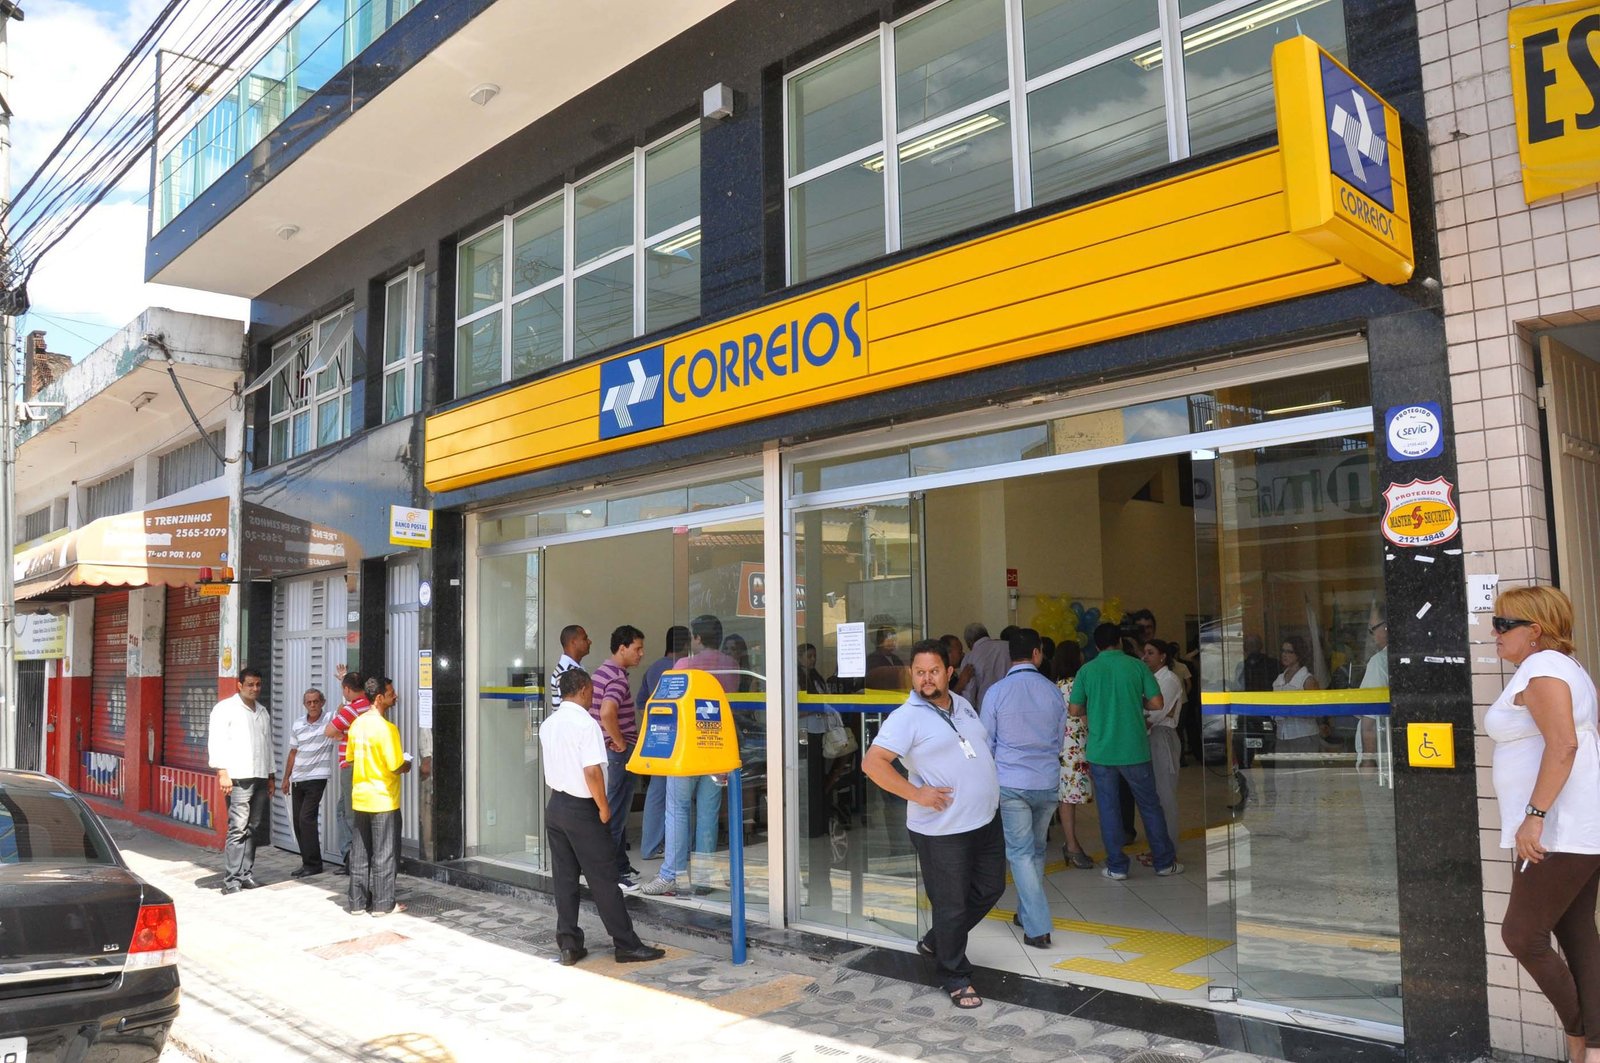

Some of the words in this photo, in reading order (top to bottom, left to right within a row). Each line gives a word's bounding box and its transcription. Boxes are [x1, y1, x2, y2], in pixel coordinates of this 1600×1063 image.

[1522, 14, 1600, 144] ES
[1340, 187, 1394, 240] CORREIOS
[668, 301, 862, 403] CORREIOS
[1395, 408, 1431, 421] PROTEGIDO
[1395, 490, 1442, 501] PROTEGIDO
[145, 517, 152, 526] E
[155, 513, 213, 526] TRENZINHOS
[1390, 514, 1412, 528] MASTER
[1424, 508, 1452, 524] SECURITY
[395, 521, 410, 529] BANCO
[411, 523, 427, 531] POSTAL
[175, 528, 227, 538] 2565-2079
[1398, 531, 1446, 543] 2121-4848
[186, 551, 202, 559] 1,00
